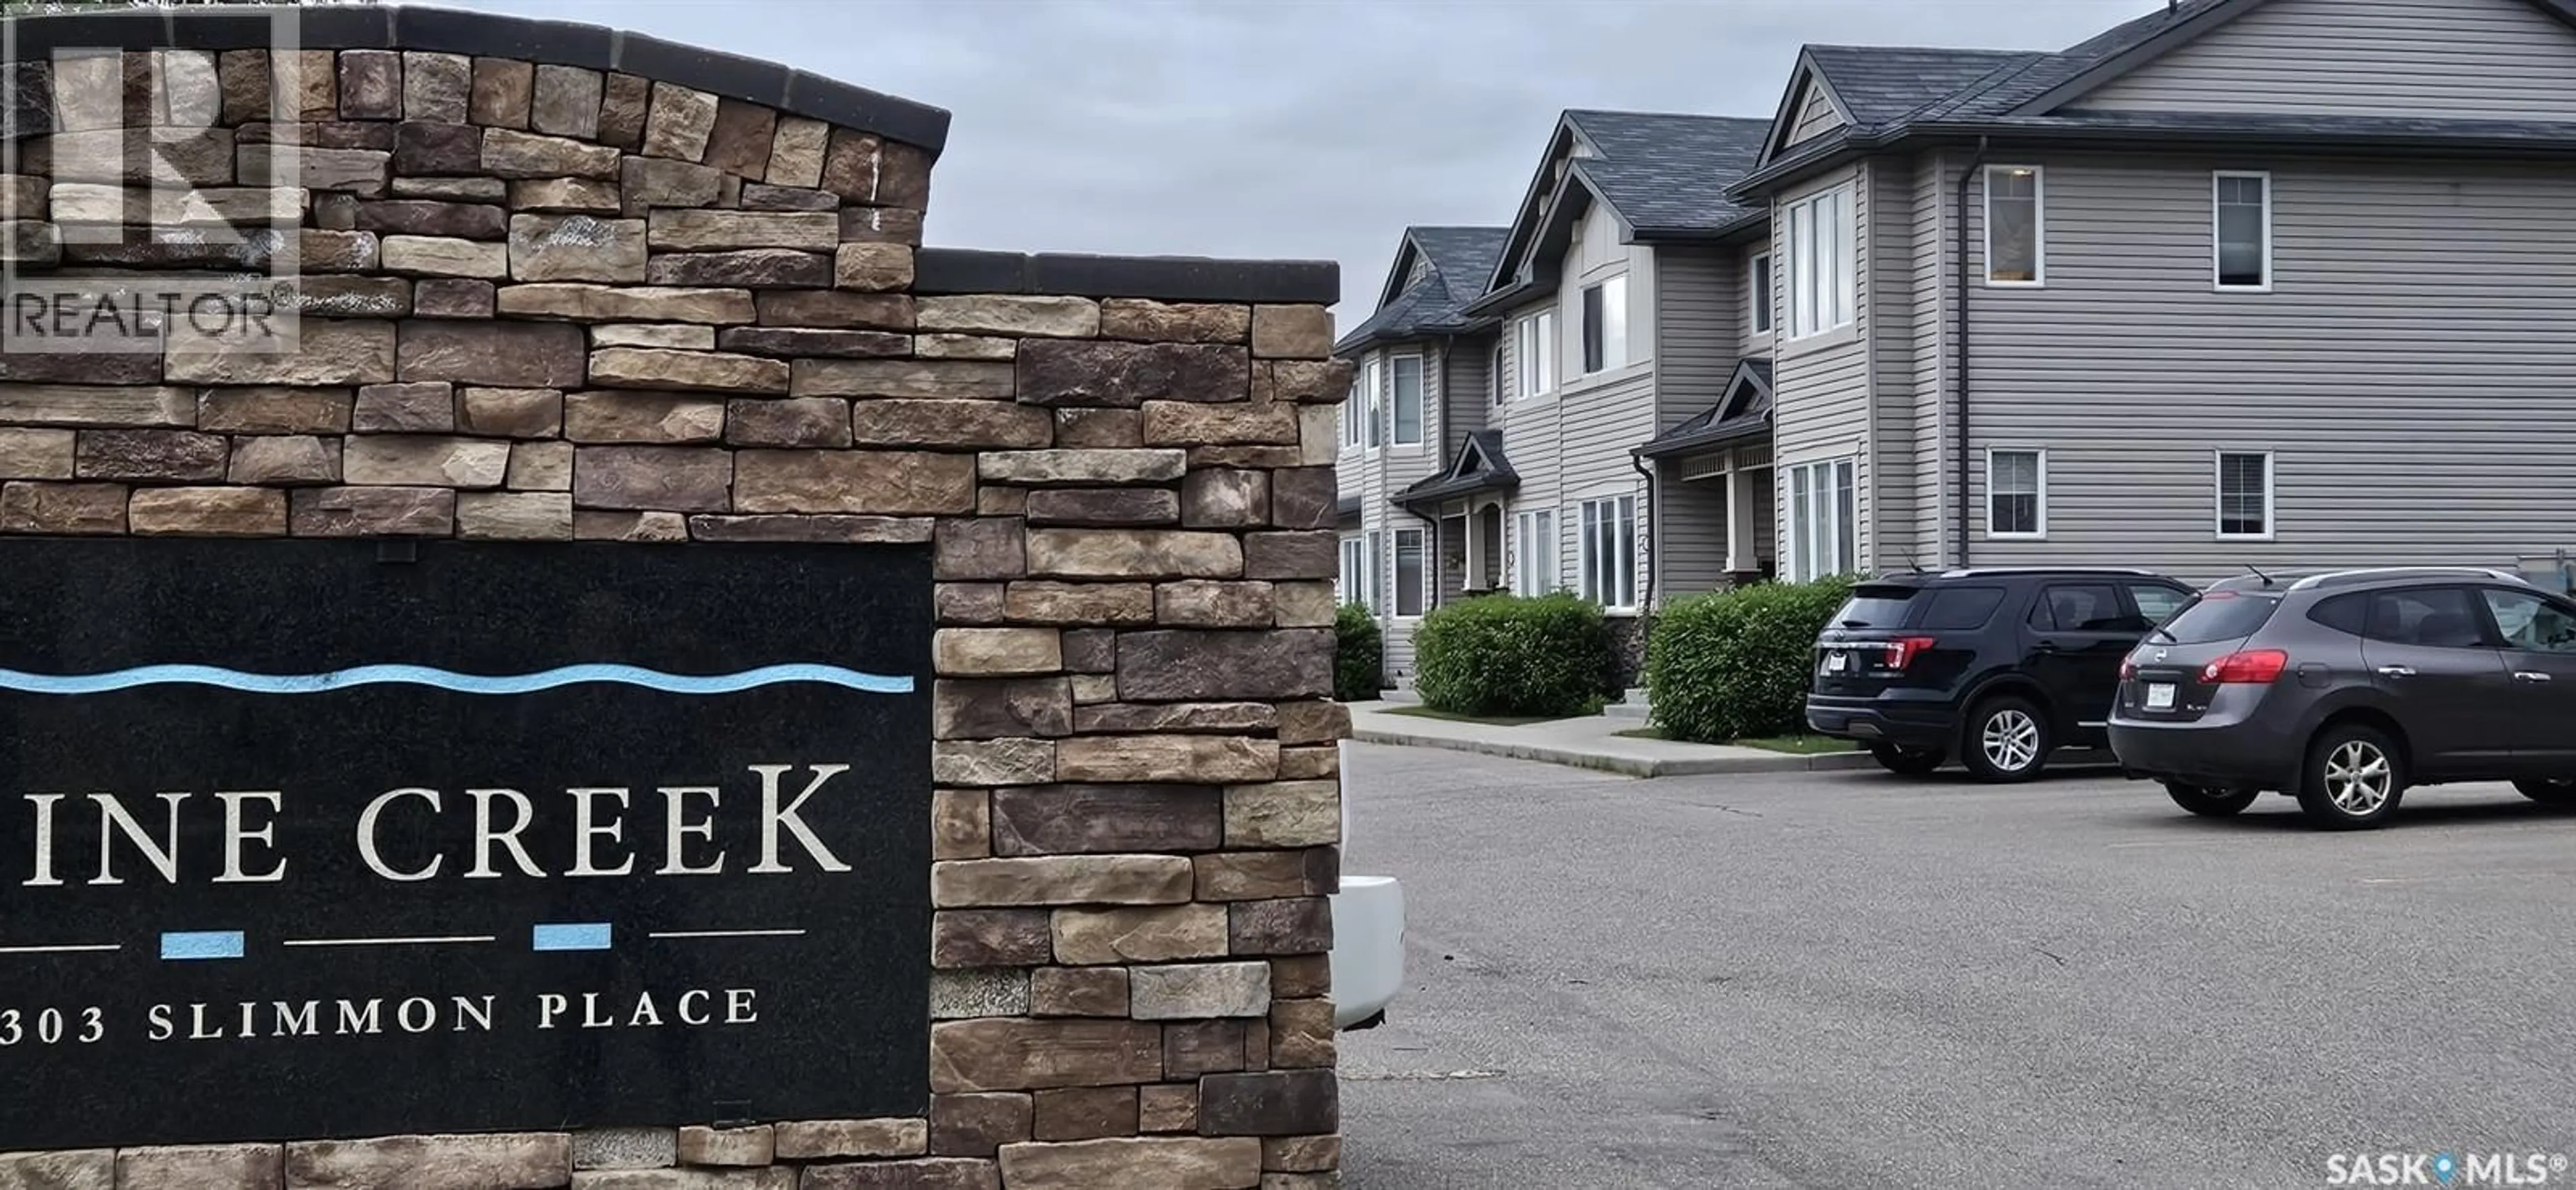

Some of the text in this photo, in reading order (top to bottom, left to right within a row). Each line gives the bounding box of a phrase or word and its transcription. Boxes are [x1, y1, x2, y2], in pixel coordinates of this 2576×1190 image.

[22, 763, 852, 886] INE CREEK
[0, 989, 757, 1045] 303 SLIMMON PLACE
